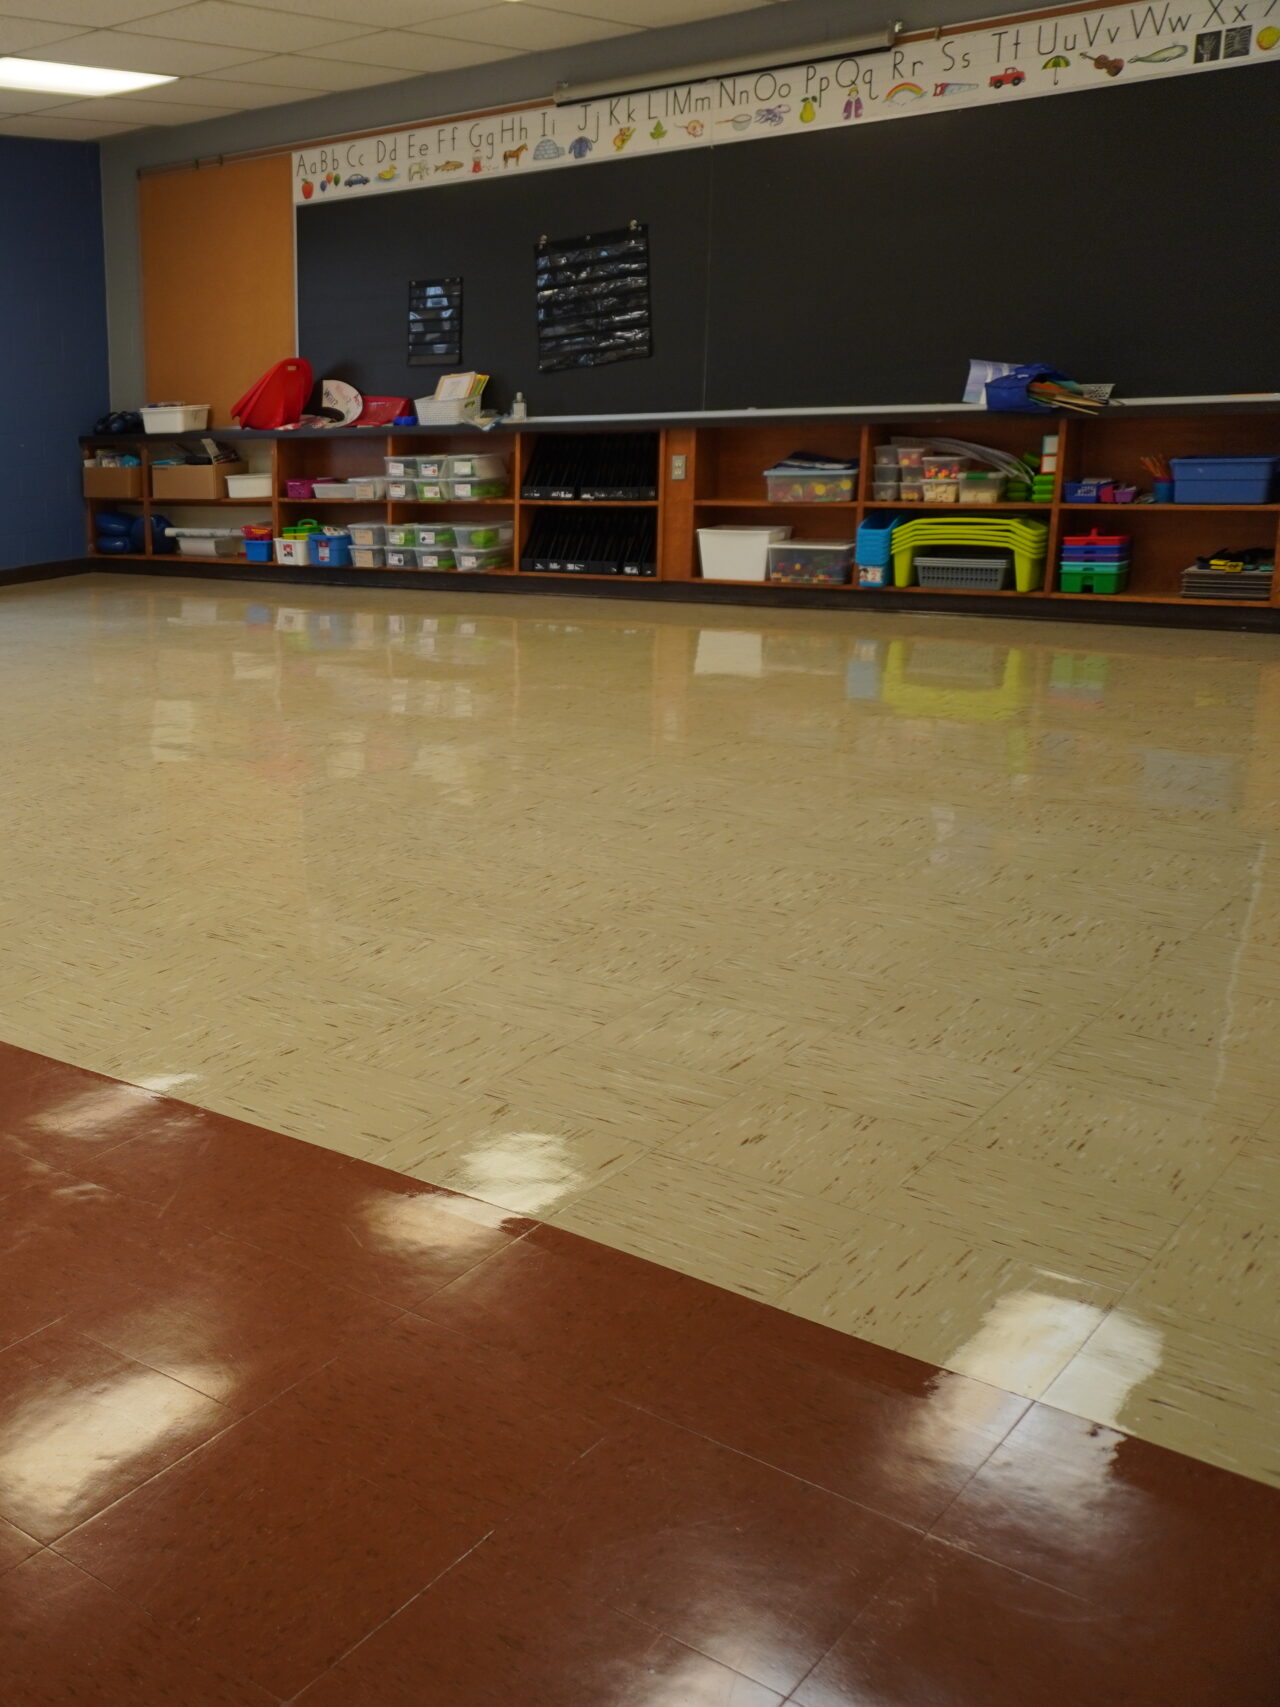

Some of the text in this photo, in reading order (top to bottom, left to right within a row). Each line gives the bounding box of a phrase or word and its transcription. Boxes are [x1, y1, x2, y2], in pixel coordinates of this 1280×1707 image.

[296, 153, 317, 177] Aa
[320, 150, 340, 173] Bb
[346, 145, 365, 168] Cc
[376, 136, 398, 163] Dd
[407, 134, 429, 159] Ee
[437, 126, 458, 154] Ff
[469, 123, 495, 160] Gg
[501, 116, 528, 144] Hh
[541, 112, 556, 137] Ii
[578, 104, 600, 144] Jj
[609, 97, 637, 126] Kk
[647, 89, 669, 121] Ll
[672, 87, 712, 116] Mm
[719, 77, 750, 108] Nn
[754, 73, 792, 101] Oo
[805, 65, 830, 108] Pp
[835, 58, 879, 101] Qq
[892, 50, 924, 80] Rr
[942, 40, 971, 72] Ss
[992, 29, 1021, 63] Tt
[1037, 22, 1077, 55] Uu
[1083, 13, 1120, 48] Vv
[1131, 2, 1192, 39] Ww
